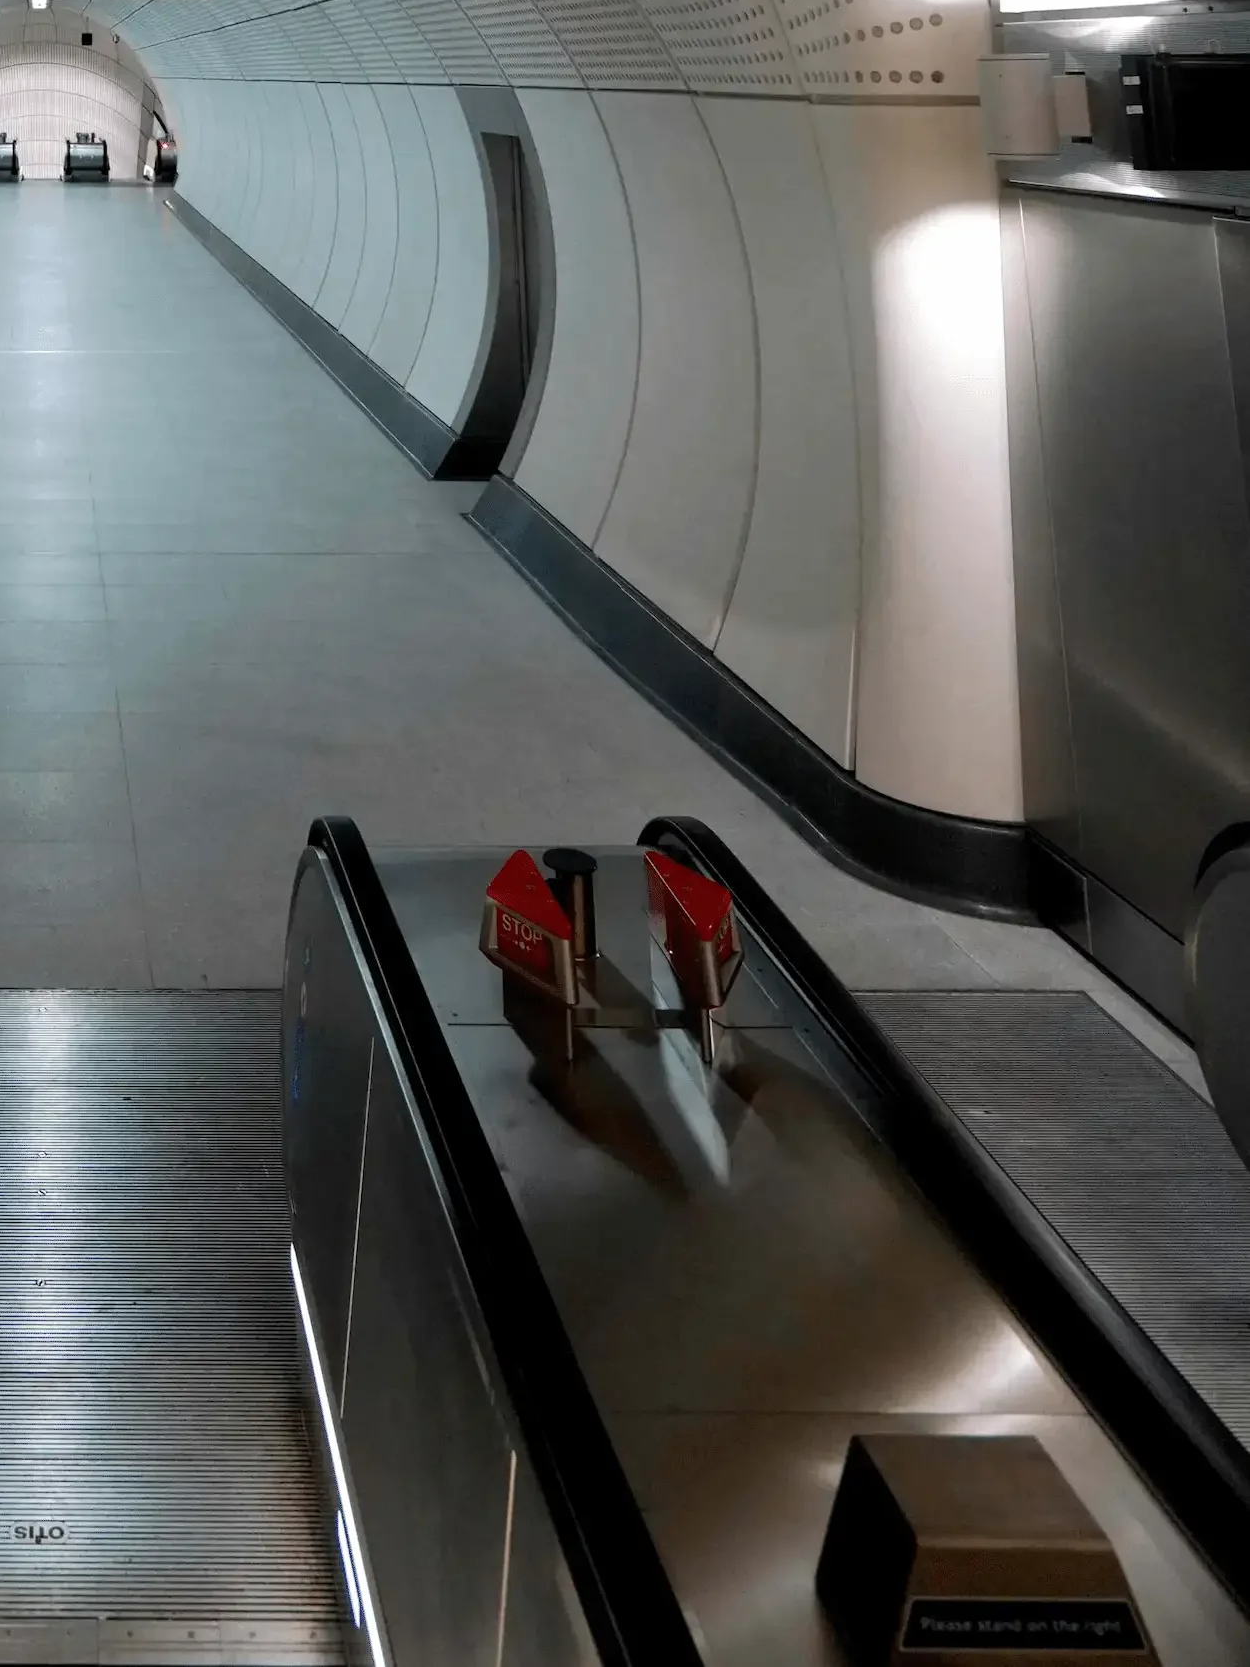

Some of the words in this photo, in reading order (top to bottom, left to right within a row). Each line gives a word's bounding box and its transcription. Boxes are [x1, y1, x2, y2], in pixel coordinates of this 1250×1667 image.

[501, 913, 543, 945] STOP
[13, 1525, 65, 1540] OTIS
[919, 1615, 973, 1633] Please
[976, 1617, 1023, 1633] stand
[1051, 1618, 1081, 1633] the
